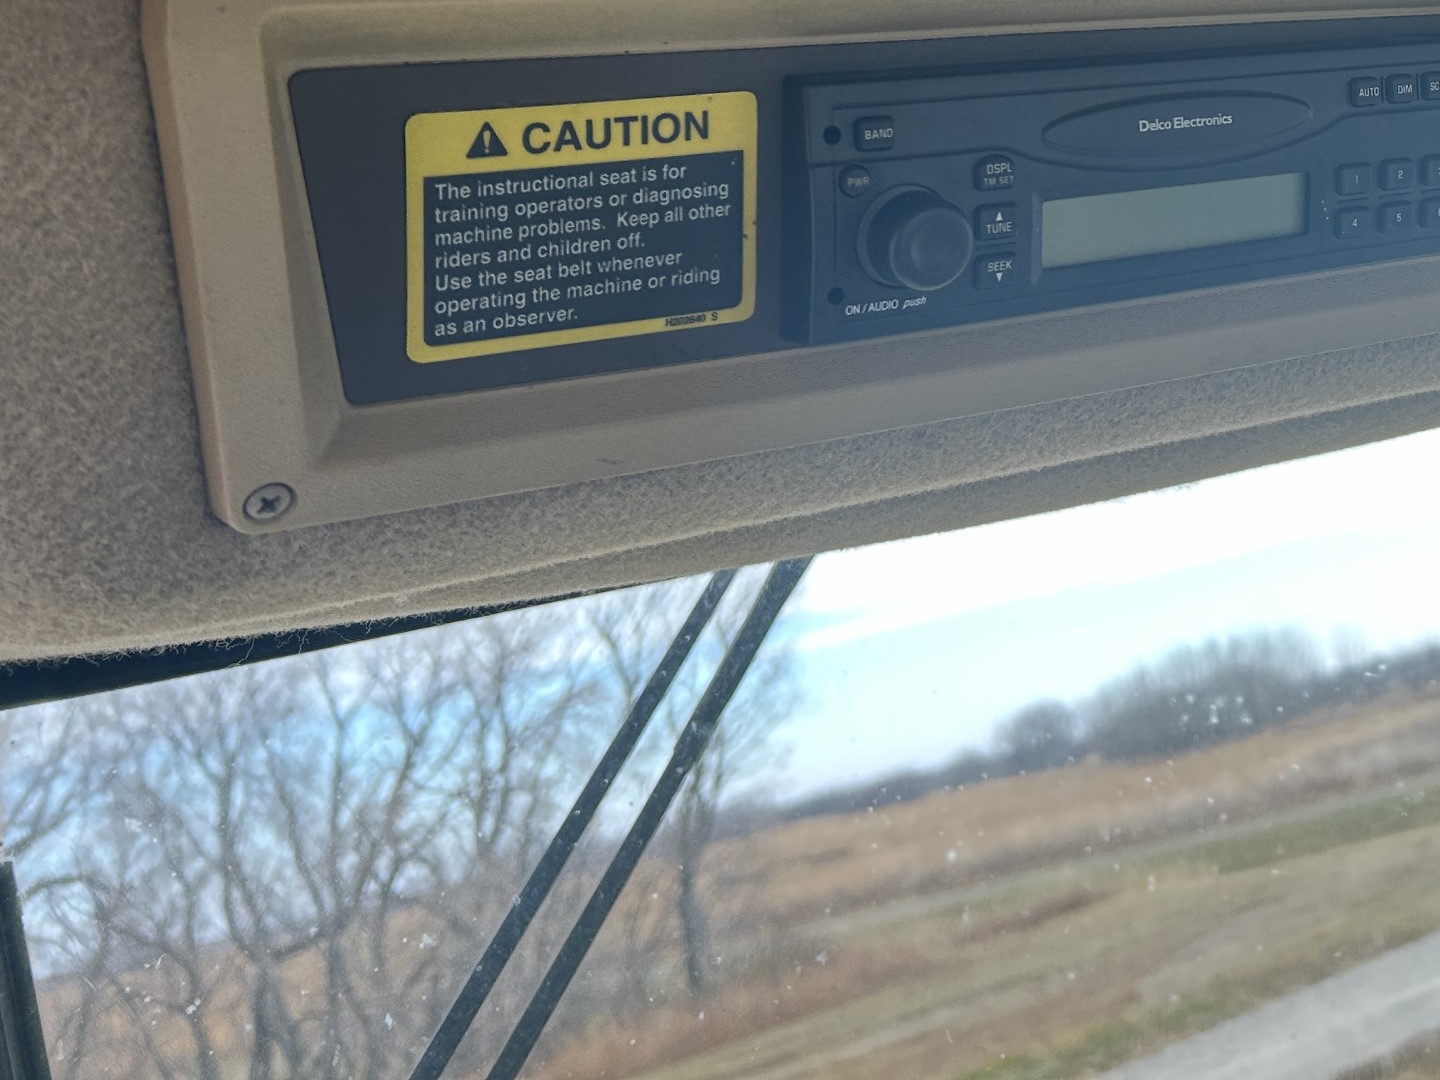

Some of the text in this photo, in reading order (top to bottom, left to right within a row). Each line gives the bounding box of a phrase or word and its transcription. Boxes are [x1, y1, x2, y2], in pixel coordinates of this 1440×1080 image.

[1359, 86, 1379, 97] AUTO
[1397, 84, 1413, 94] DIM
[1139, 113, 1233, 132] Delco Electronics
[522, 110, 709, 154] CAUTION
[864, 128, 894, 140] BAND
[986, 163, 1013, 175] DSPL
[1398, 170, 1403, 179] 2
[435, 164, 687, 200] The instructional seat is for
[847, 176, 870, 188] PWR
[984, 175, 1014, 186] TM SET
[1355, 175, 1358, 183] 1
[435, 182, 729, 224] training operators or diagnosing
[1352, 219, 1358, 228] 4
[1397, 213, 1402, 222] 5
[435, 203, 731, 246] machine problems. Keep all other
[986, 222, 1013, 234] TUNE
[435, 233, 646, 269] riders and children off.
[435, 251, 682, 292] Use the seat belt whenever
[988, 260, 1013, 271] SEEK
[435, 268, 720, 317] operating the machine or riding
[903, 295, 927, 310] push
[434, 307, 578, 337] as an observer.
